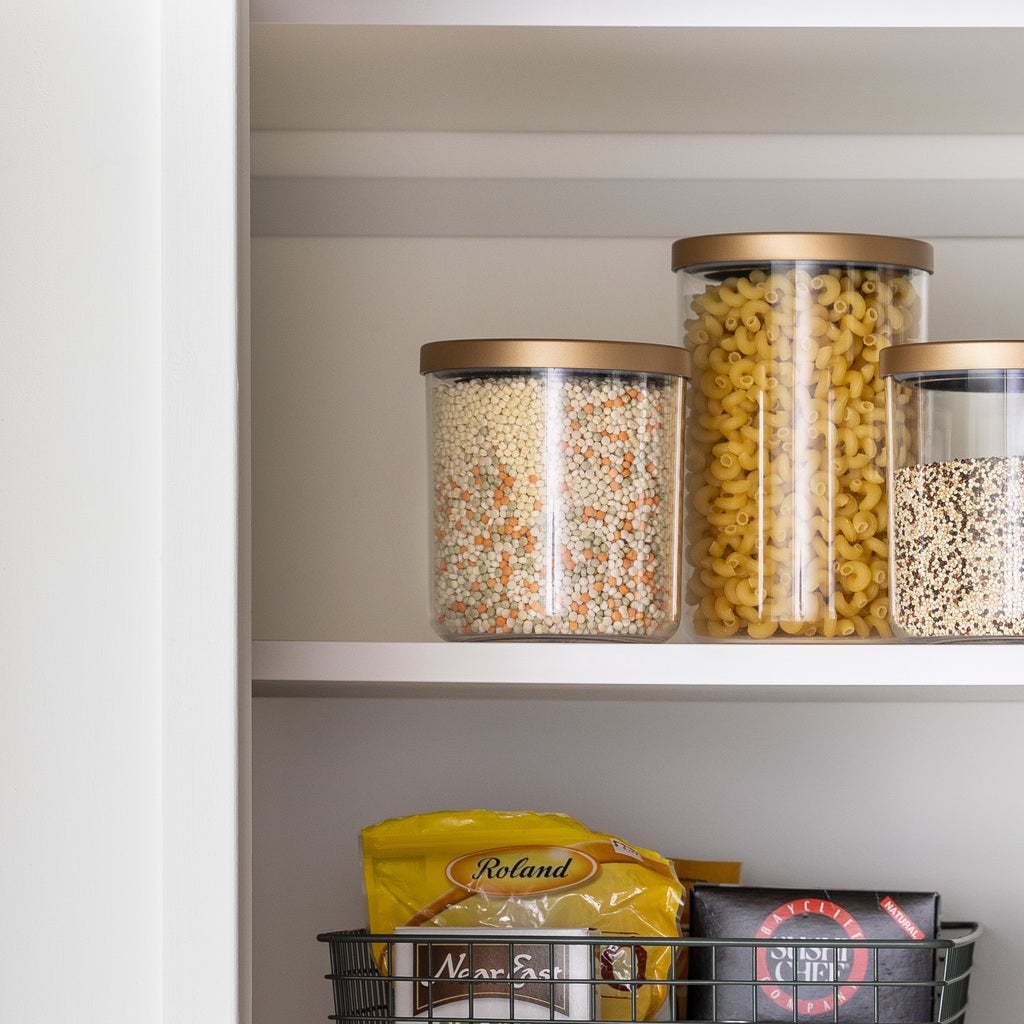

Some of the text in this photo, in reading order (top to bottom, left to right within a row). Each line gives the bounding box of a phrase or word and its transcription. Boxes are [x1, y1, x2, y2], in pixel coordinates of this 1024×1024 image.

[471, 856, 573, 881] Roland
[760, 900, 863, 938] BAYCLIFF
[884, 901, 919, 938] NATURAL
[771, 936, 848, 961] SUSHI
[420, 952, 563, 989] Near East
[775, 961, 846, 981] CHEF
[760, 976, 858, 1013] OMPAN
